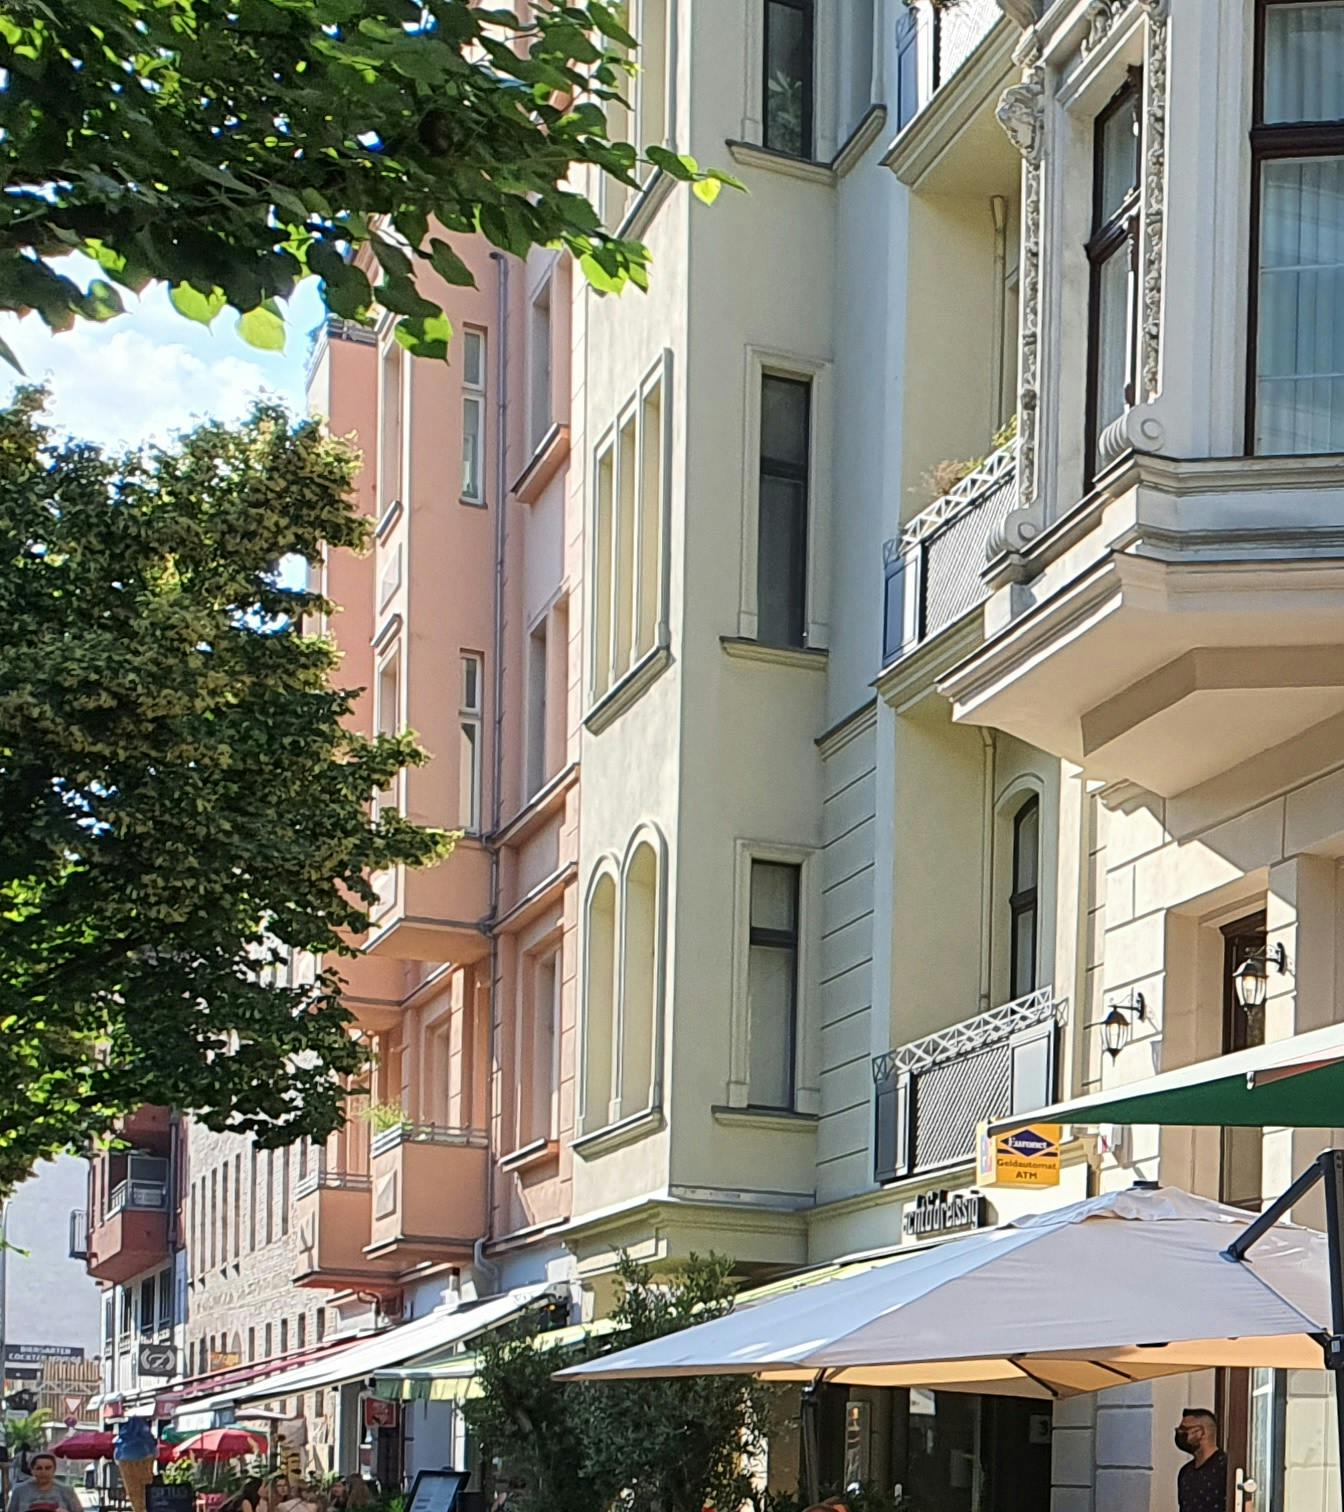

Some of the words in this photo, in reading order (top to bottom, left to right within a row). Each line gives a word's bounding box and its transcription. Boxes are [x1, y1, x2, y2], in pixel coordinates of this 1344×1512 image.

[1007, 1137, 1048, 1149] Euronet
[996, 1157, 1057, 1171] Geldautomat
[1015, 1171, 1038, 1180] ATM
